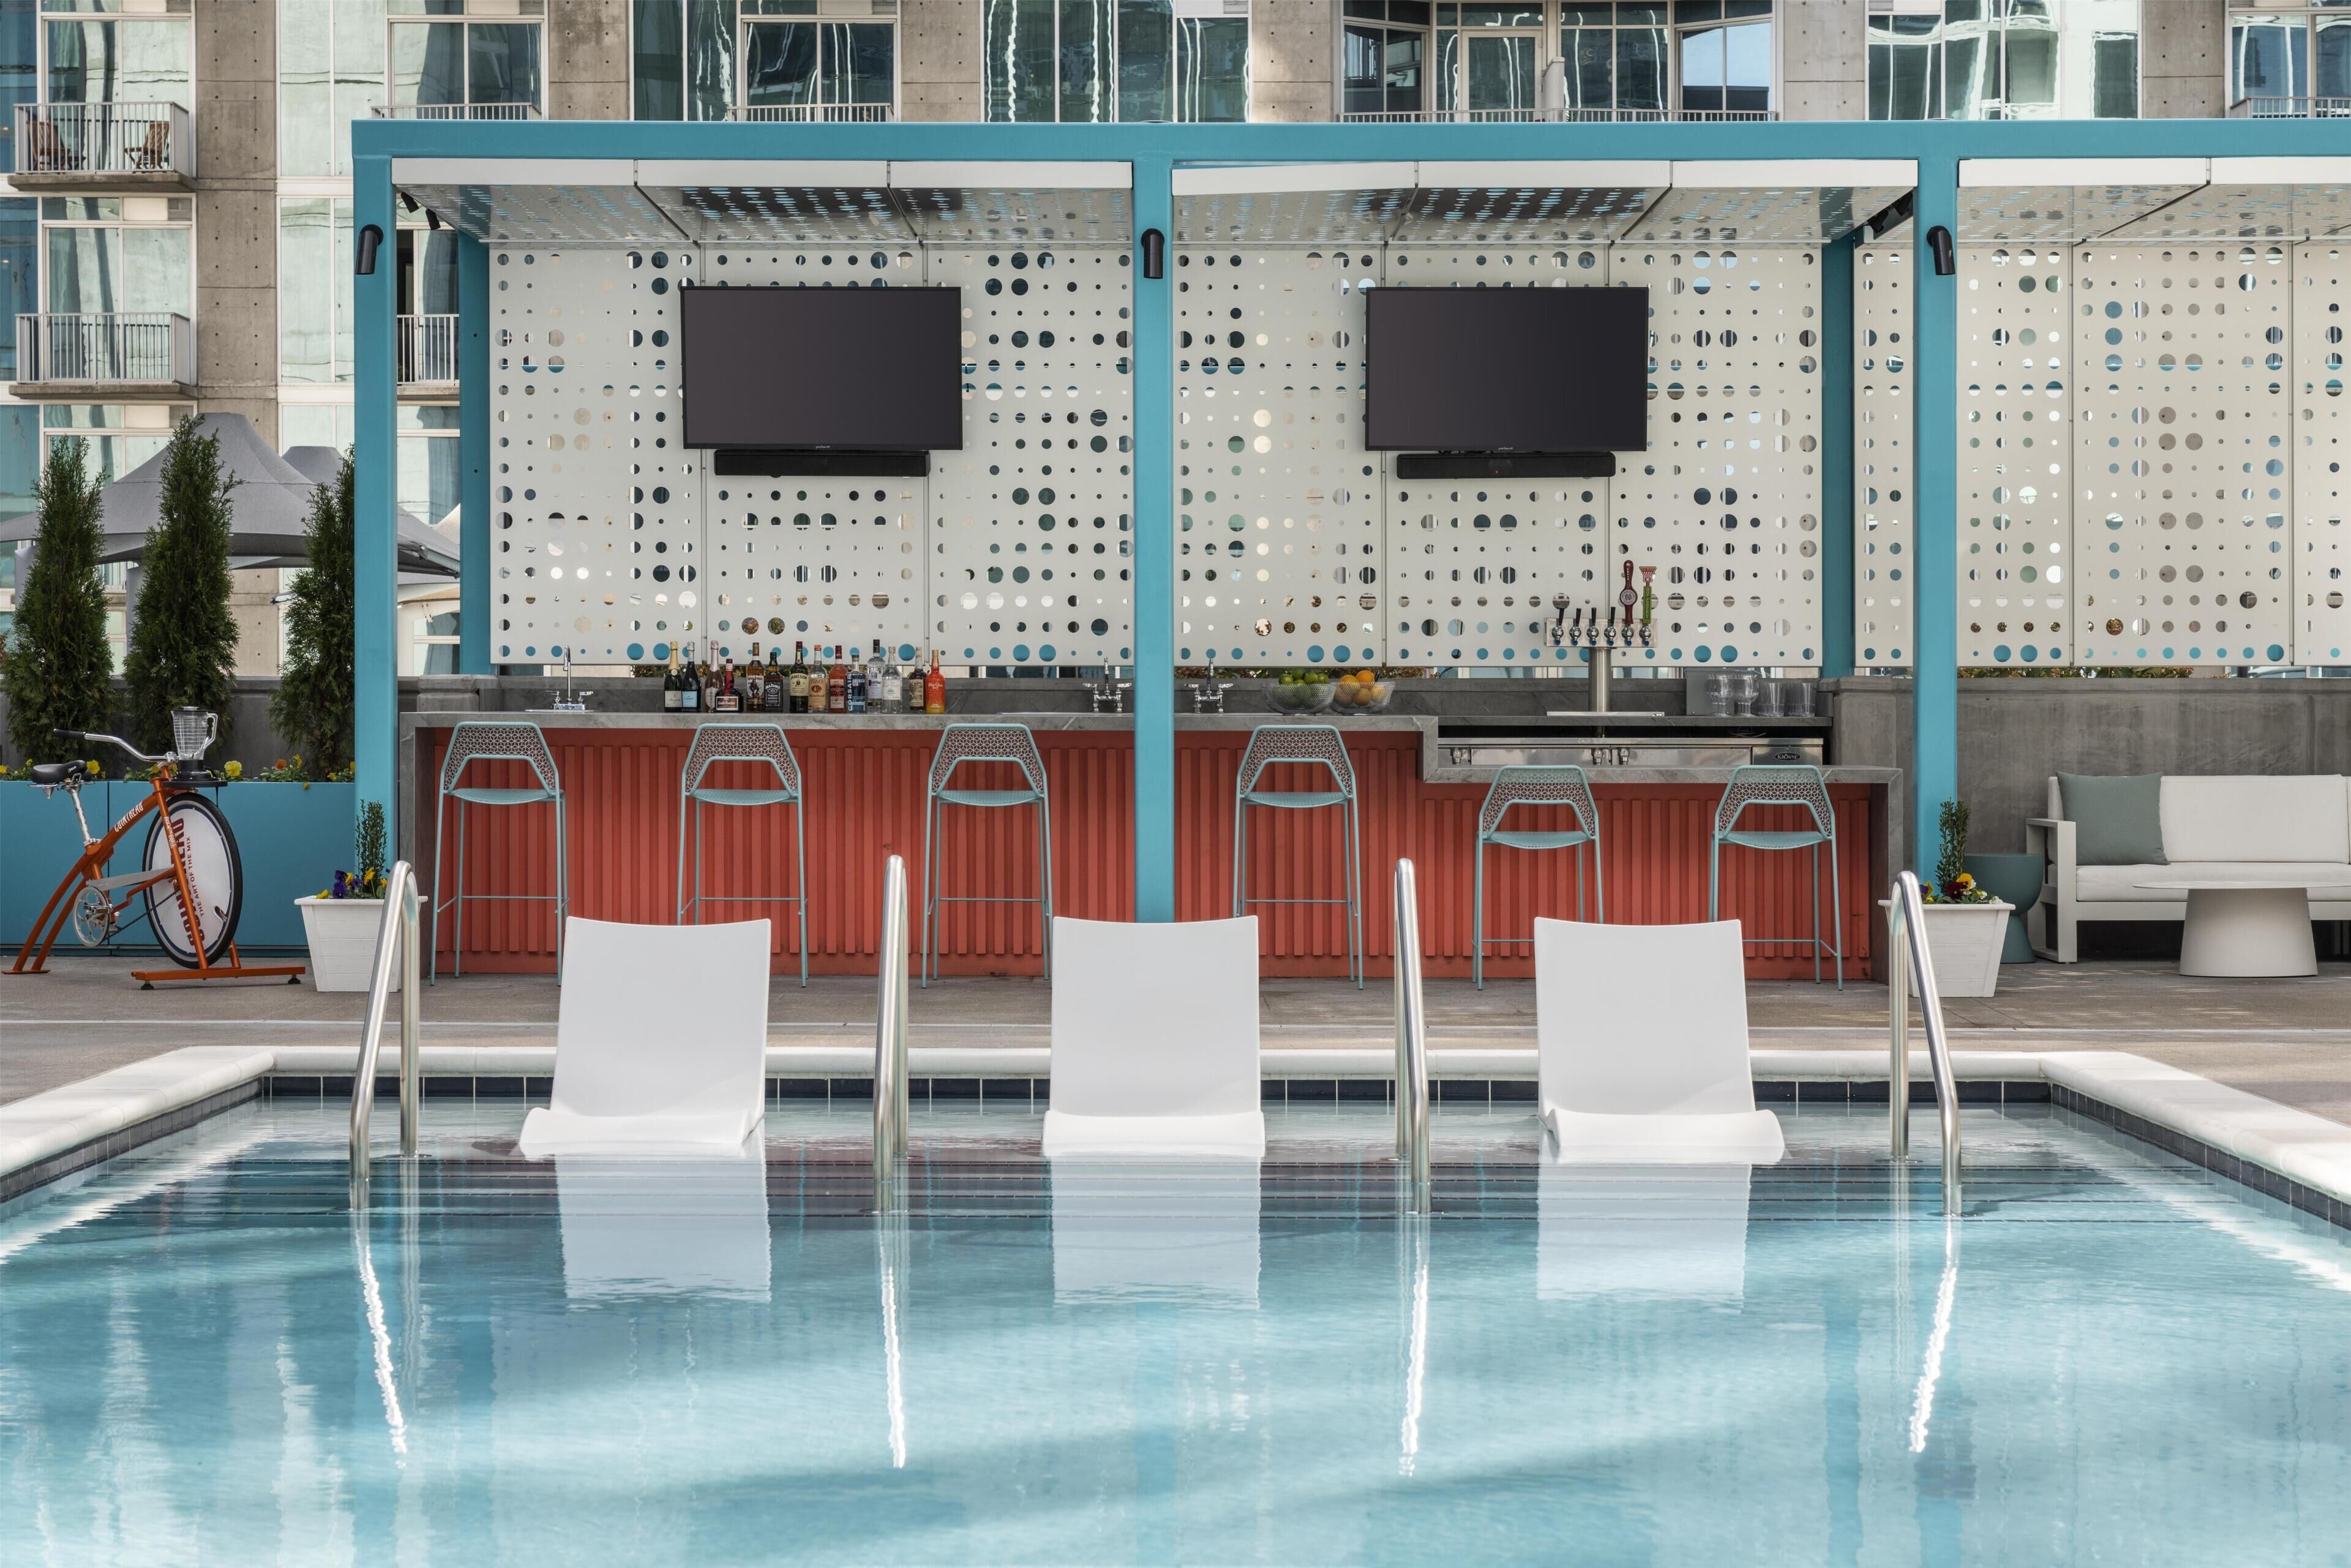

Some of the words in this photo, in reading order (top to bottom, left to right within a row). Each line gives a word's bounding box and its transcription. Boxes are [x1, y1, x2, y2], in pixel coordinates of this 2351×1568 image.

[114, 801, 144, 833] COINTREAU
[168, 834, 178, 849] BIKE
[189, 871, 195, 882] OF
[191, 885, 200, 899] ART
[197, 901, 205, 917] THE
